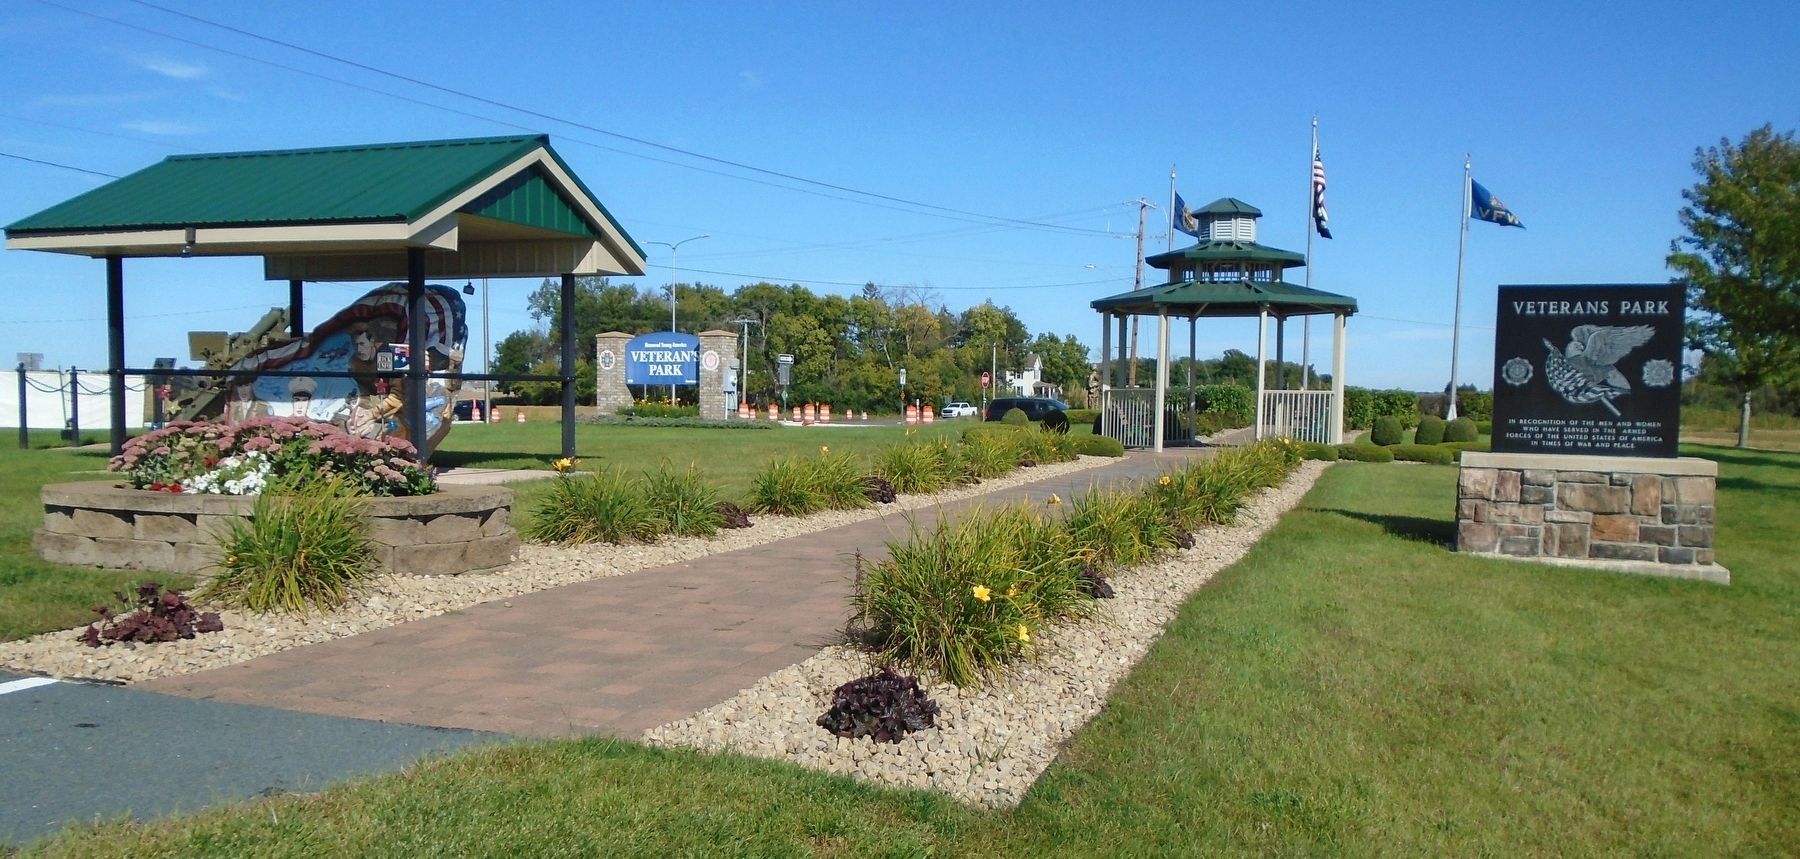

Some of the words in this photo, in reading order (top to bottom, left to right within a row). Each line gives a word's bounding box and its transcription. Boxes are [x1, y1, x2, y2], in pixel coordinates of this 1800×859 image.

[1479, 206, 1519, 225] VFW
[1513, 300, 1609, 315] VETERANS
[1619, 300, 1669, 315] PARK
[631, 350, 700, 362] VETERAN'S
[649, 364, 683, 376] PARK
